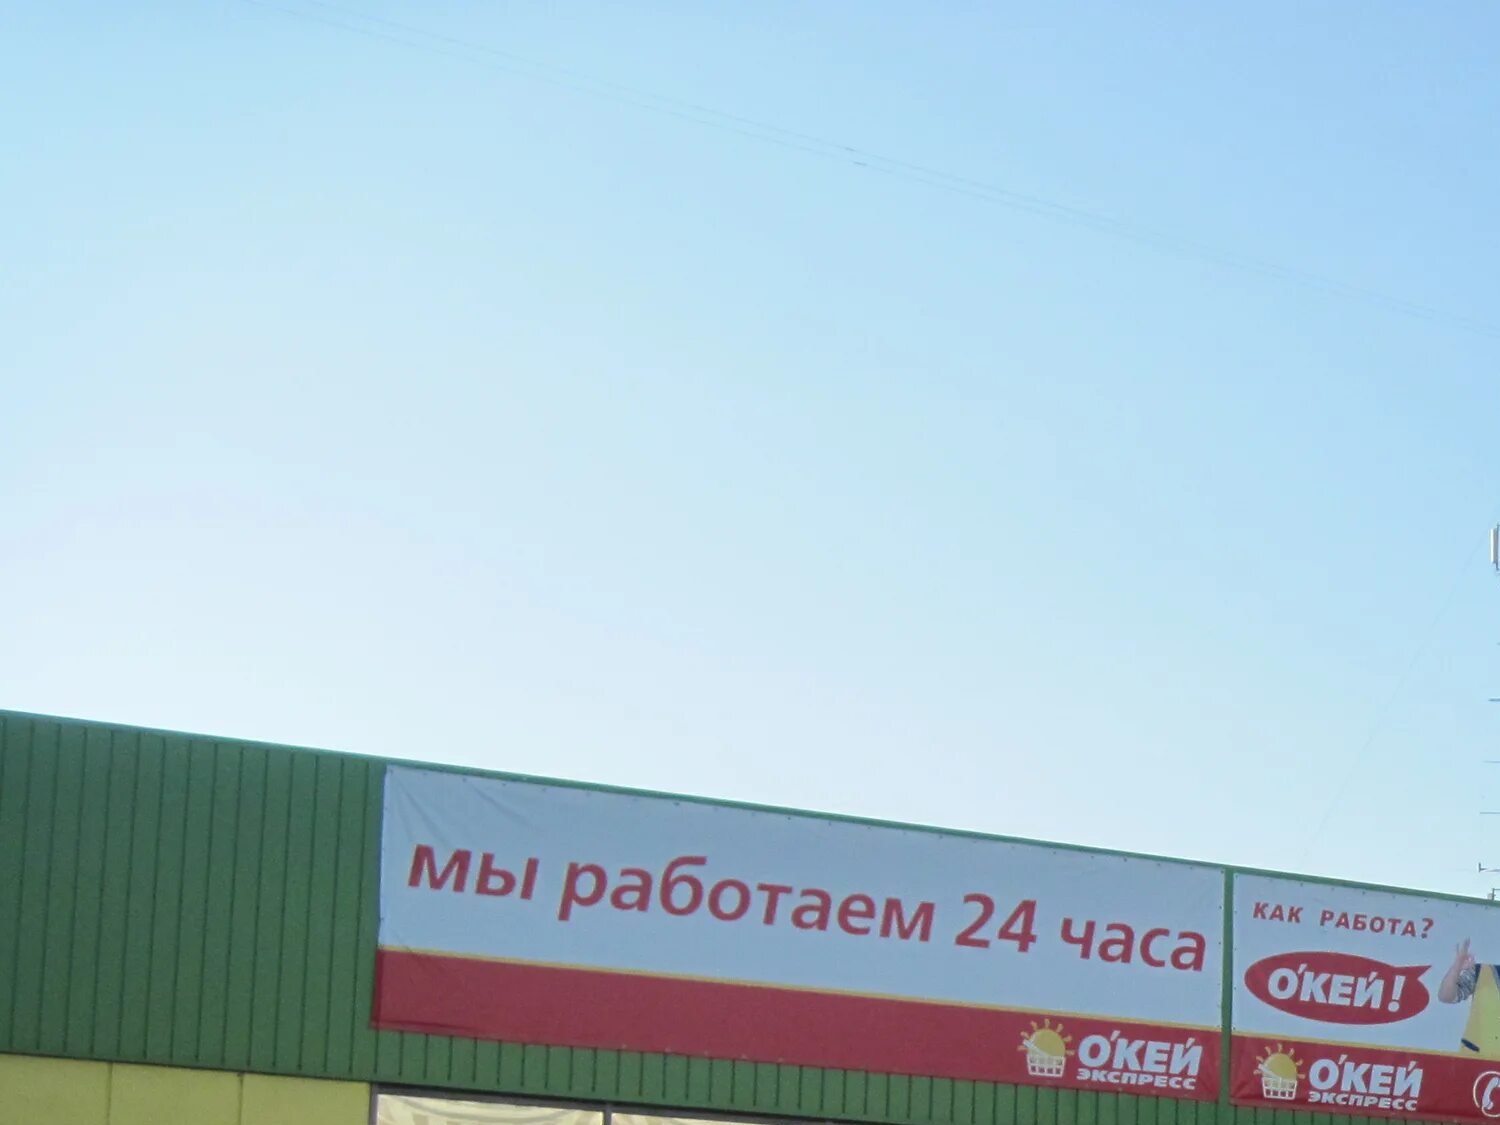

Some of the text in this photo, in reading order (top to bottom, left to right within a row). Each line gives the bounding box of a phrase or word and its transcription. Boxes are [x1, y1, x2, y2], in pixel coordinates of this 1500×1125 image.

[557, 854, 937, 943] работаем
[954, 892, 1039, 954] 24
[1059, 916, 1208, 973] часа
[1252, 901, 1434, 939] КАК РАБОТА?
[1075, 1067, 1198, 1091] ЭКСПРЕСС
[1307, 1089, 1419, 1112] ЭКСПРЕСС
